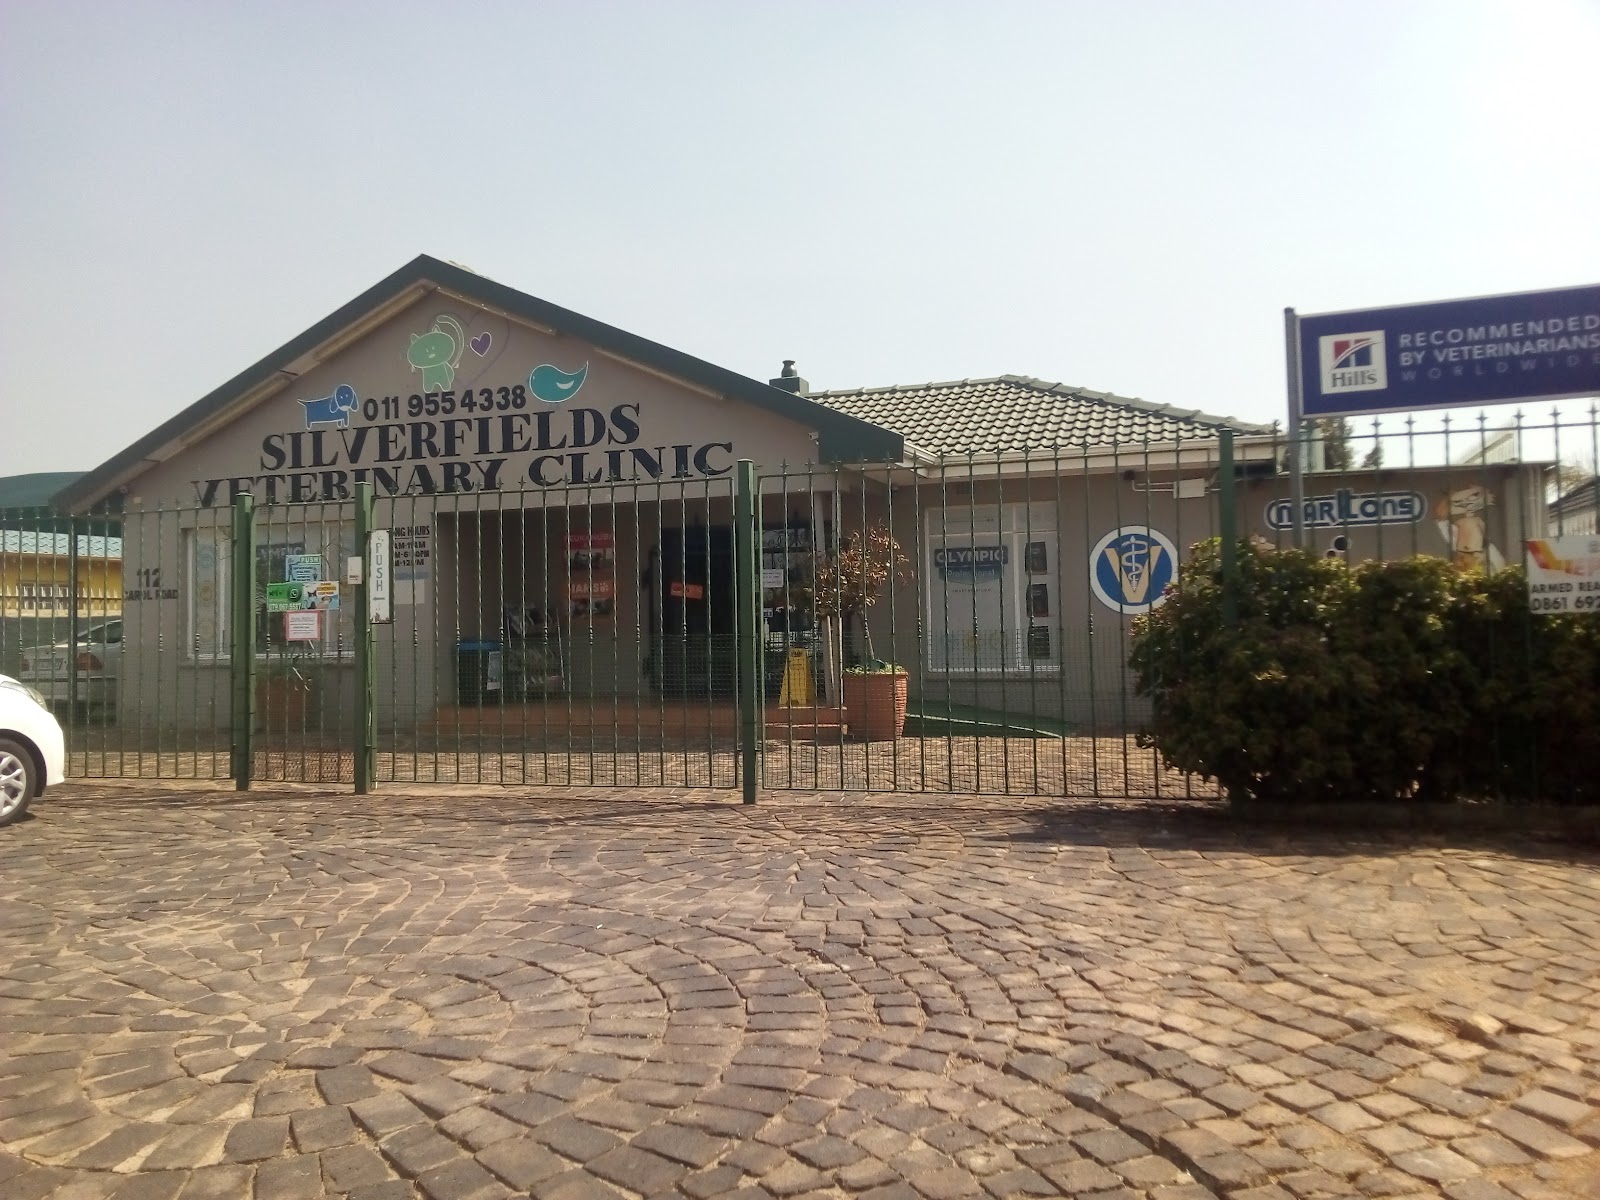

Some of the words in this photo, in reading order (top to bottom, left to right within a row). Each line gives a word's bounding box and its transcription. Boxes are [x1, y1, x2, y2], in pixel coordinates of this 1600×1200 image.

[1400, 315, 1600, 348] RECOMMENDED
[1401, 351, 1424, 367] BY
[1434, 334, 1600, 363] VETERINARIANS
[1331, 369, 1378, 388] Hill's
[1401, 356, 1600, 382] WORLDWIDE
[363, 396, 400, 421] 011
[407, 391, 456, 417] 955
[460, 384, 526, 412] 4338
[260, 402, 641, 472] SILVERFIELDS
[528, 441, 734, 487] CLINIC
[375, 542, 383, 592] PUSH
[936, 549, 1005, 563] OLYMPIC
[136, 567, 164, 588] 112
[1532, 583, 1573, 594] ARMED
[1532, 596, 1568, 611] 0861
